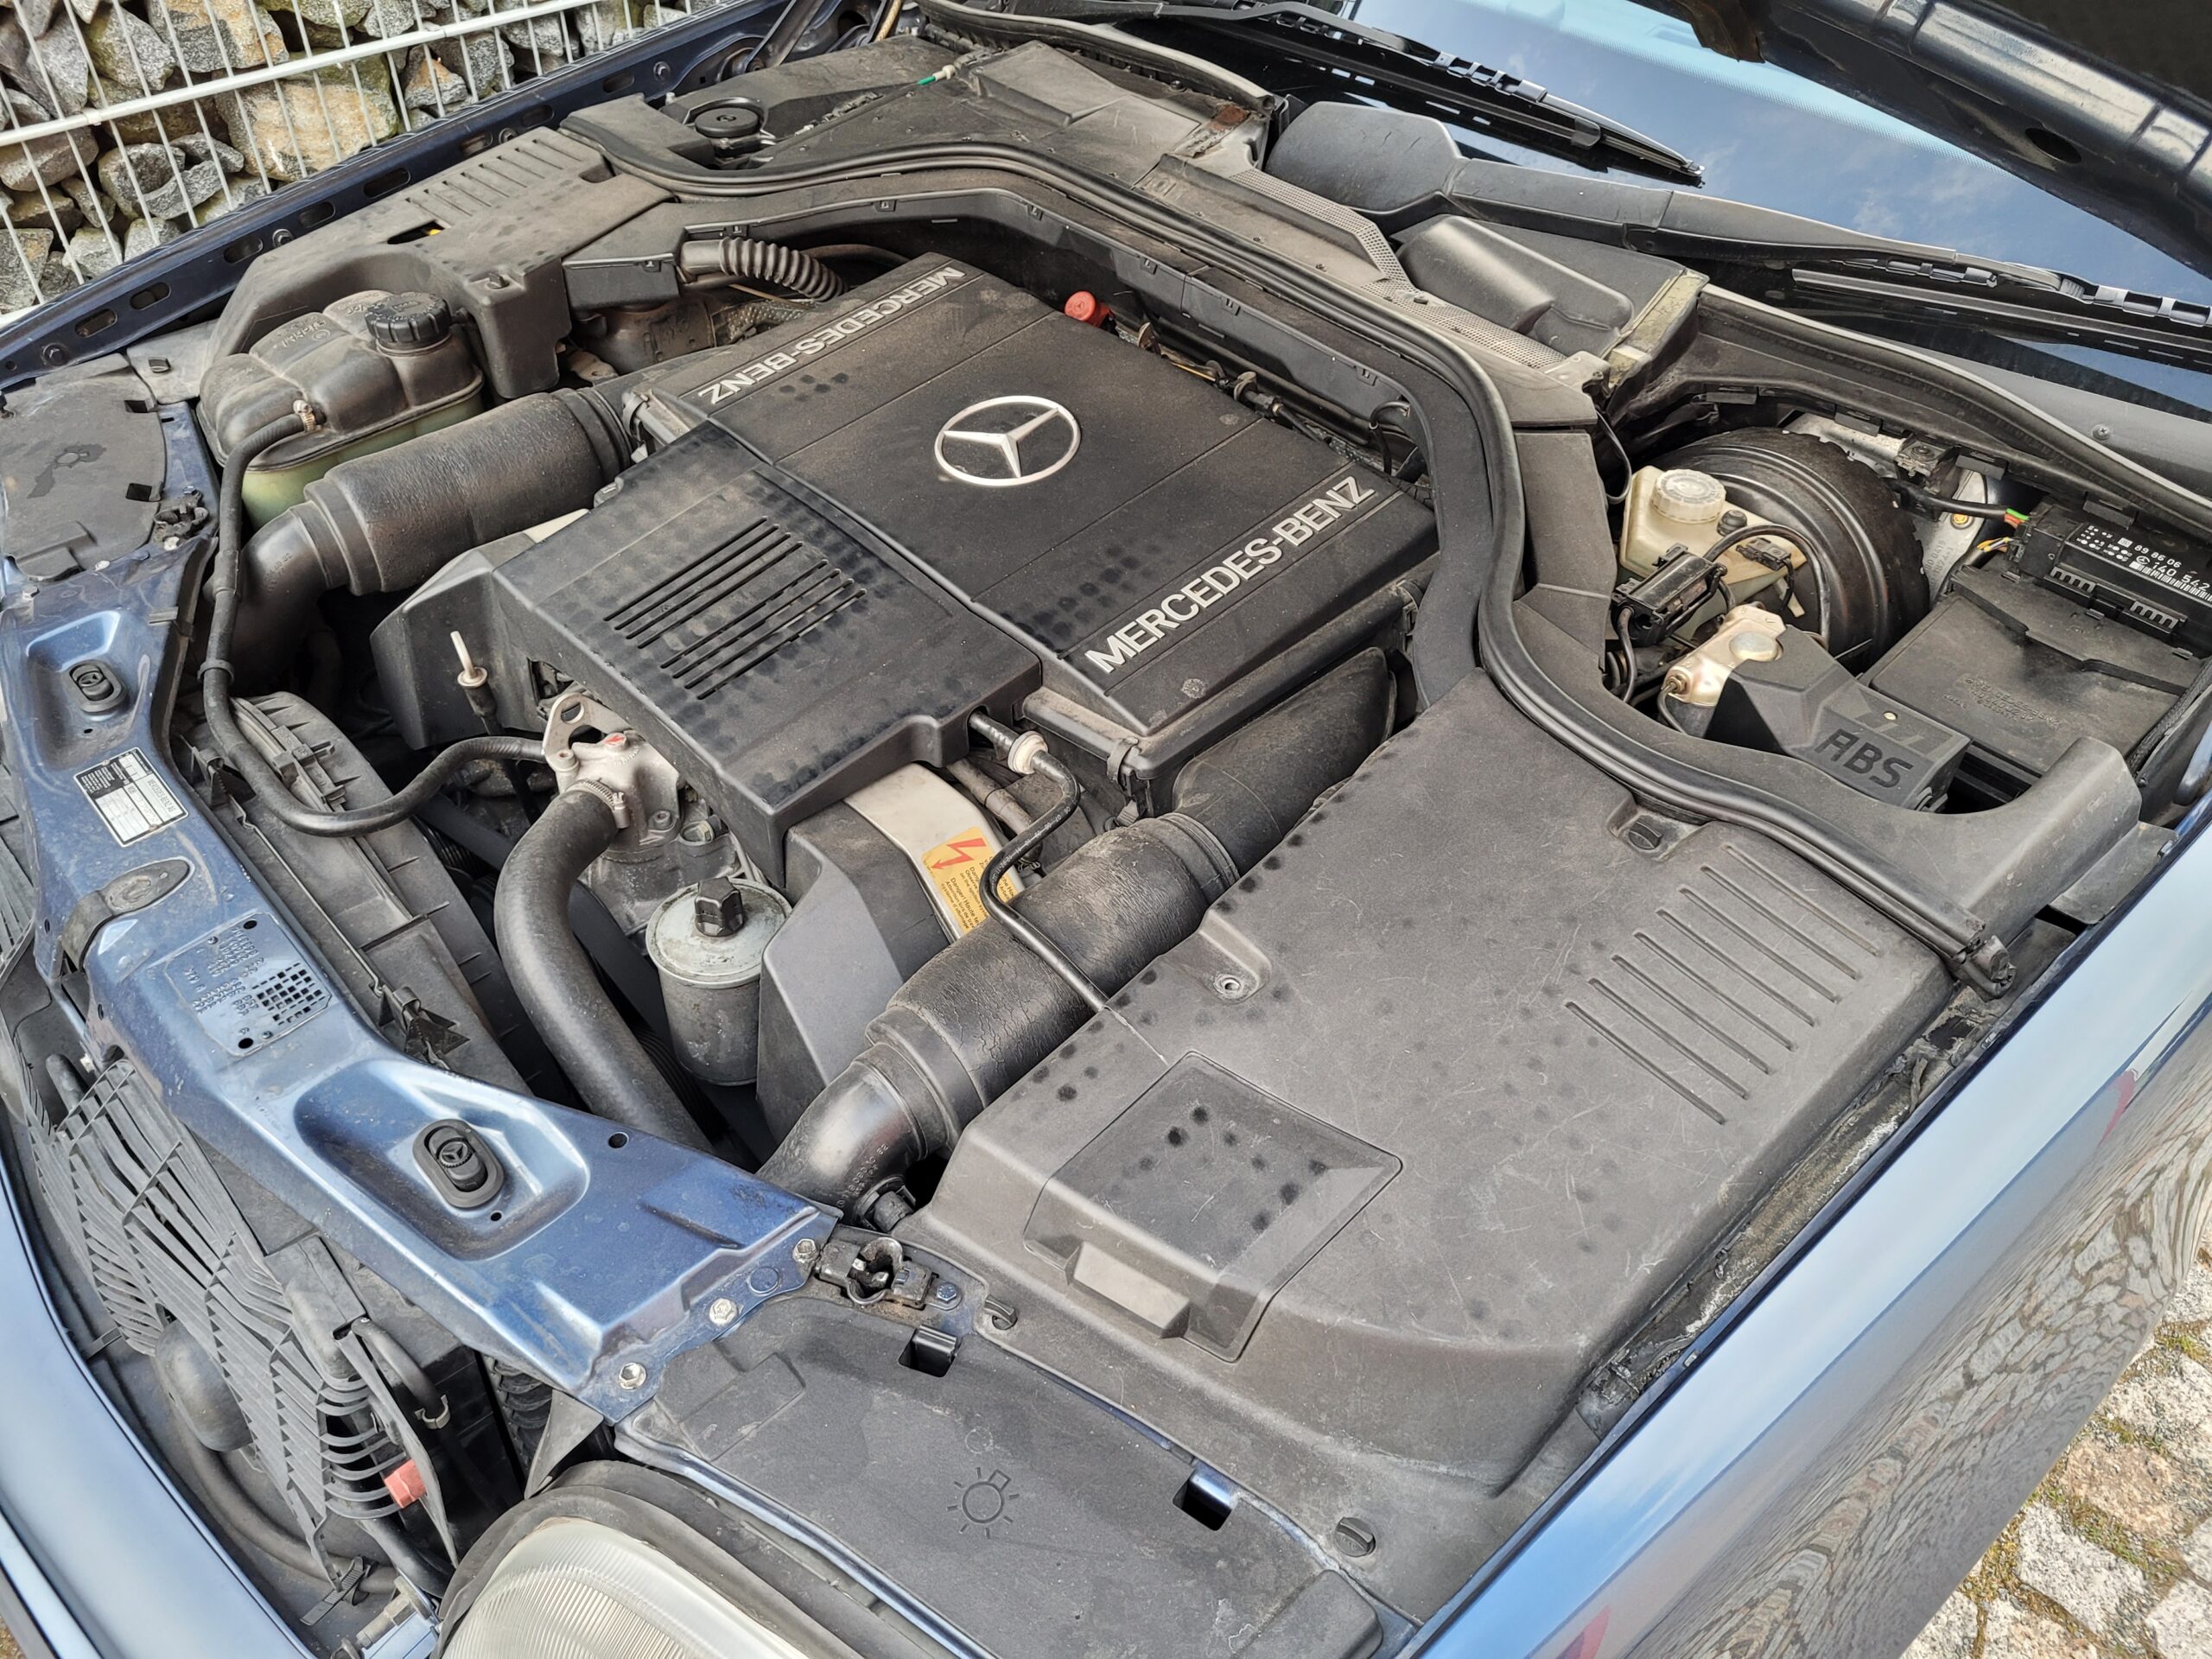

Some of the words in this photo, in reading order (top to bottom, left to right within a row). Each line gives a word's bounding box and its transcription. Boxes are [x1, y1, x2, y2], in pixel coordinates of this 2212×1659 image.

[698, 266, 966, 404] MERCEDES-BENZ
[1084, 475, 1376, 674] MERCEDES-BENZ
[2134, 544, 2150, 555] 89
[2151, 550, 2166, 562] 86
[2167, 558, 2182, 568] 06
[2152, 562, 2177, 577] 140
[2181, 574, 2210, 592] 542
[1815, 728, 1914, 788] ABS
[950, 878, 965, 899] Danger!
[964, 900, 975, 916] Haute
